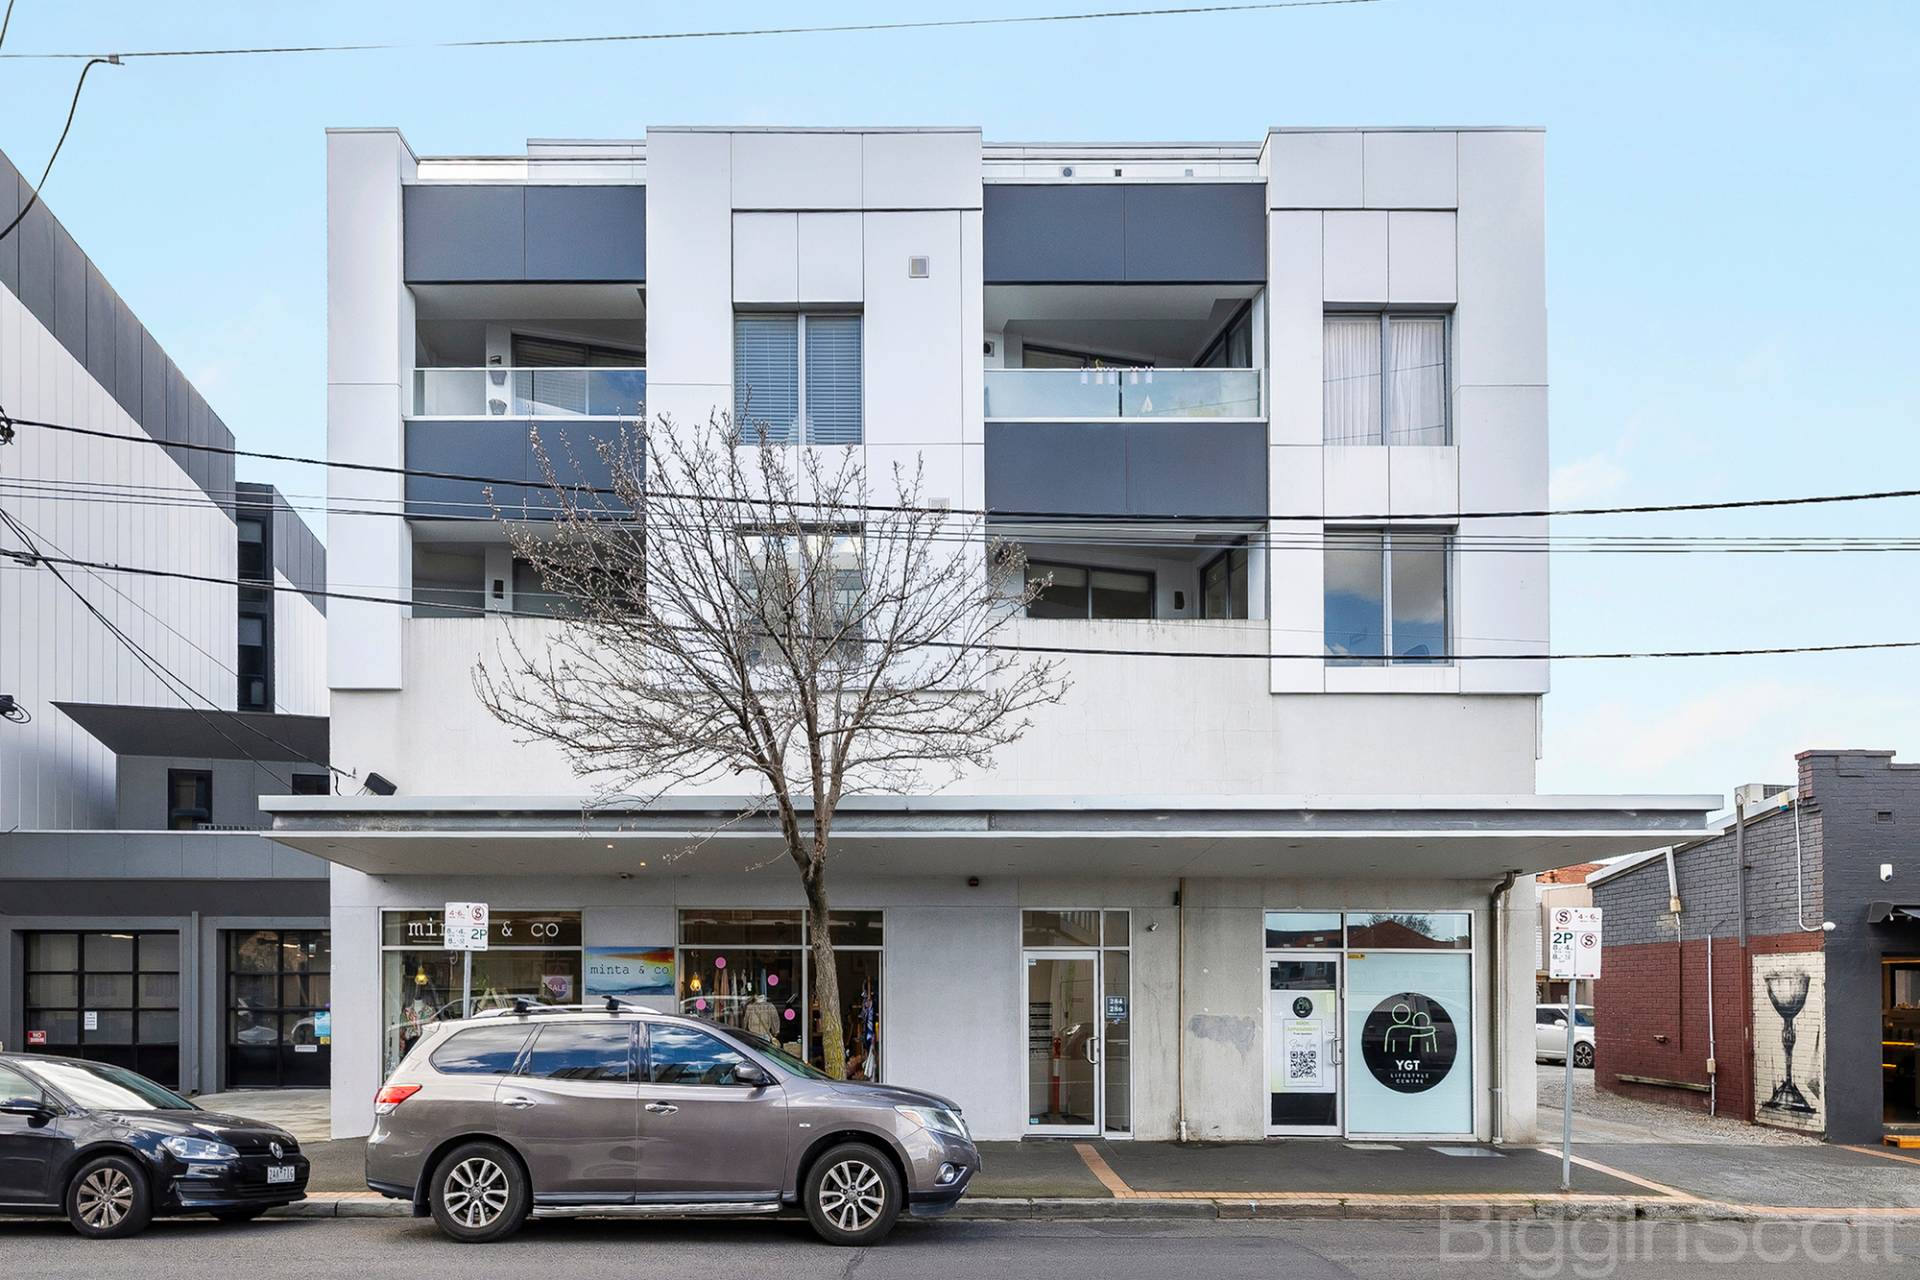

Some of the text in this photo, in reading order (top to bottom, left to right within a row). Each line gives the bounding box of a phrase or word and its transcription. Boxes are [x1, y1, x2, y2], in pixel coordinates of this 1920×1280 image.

[471, 928, 487, 940] 2P
[501, 920, 513, 937] &
[1553, 933, 1573, 944] 2P
[590, 964, 670, 975] minta & co
[1395, 1060, 1420, 1071] YGT
